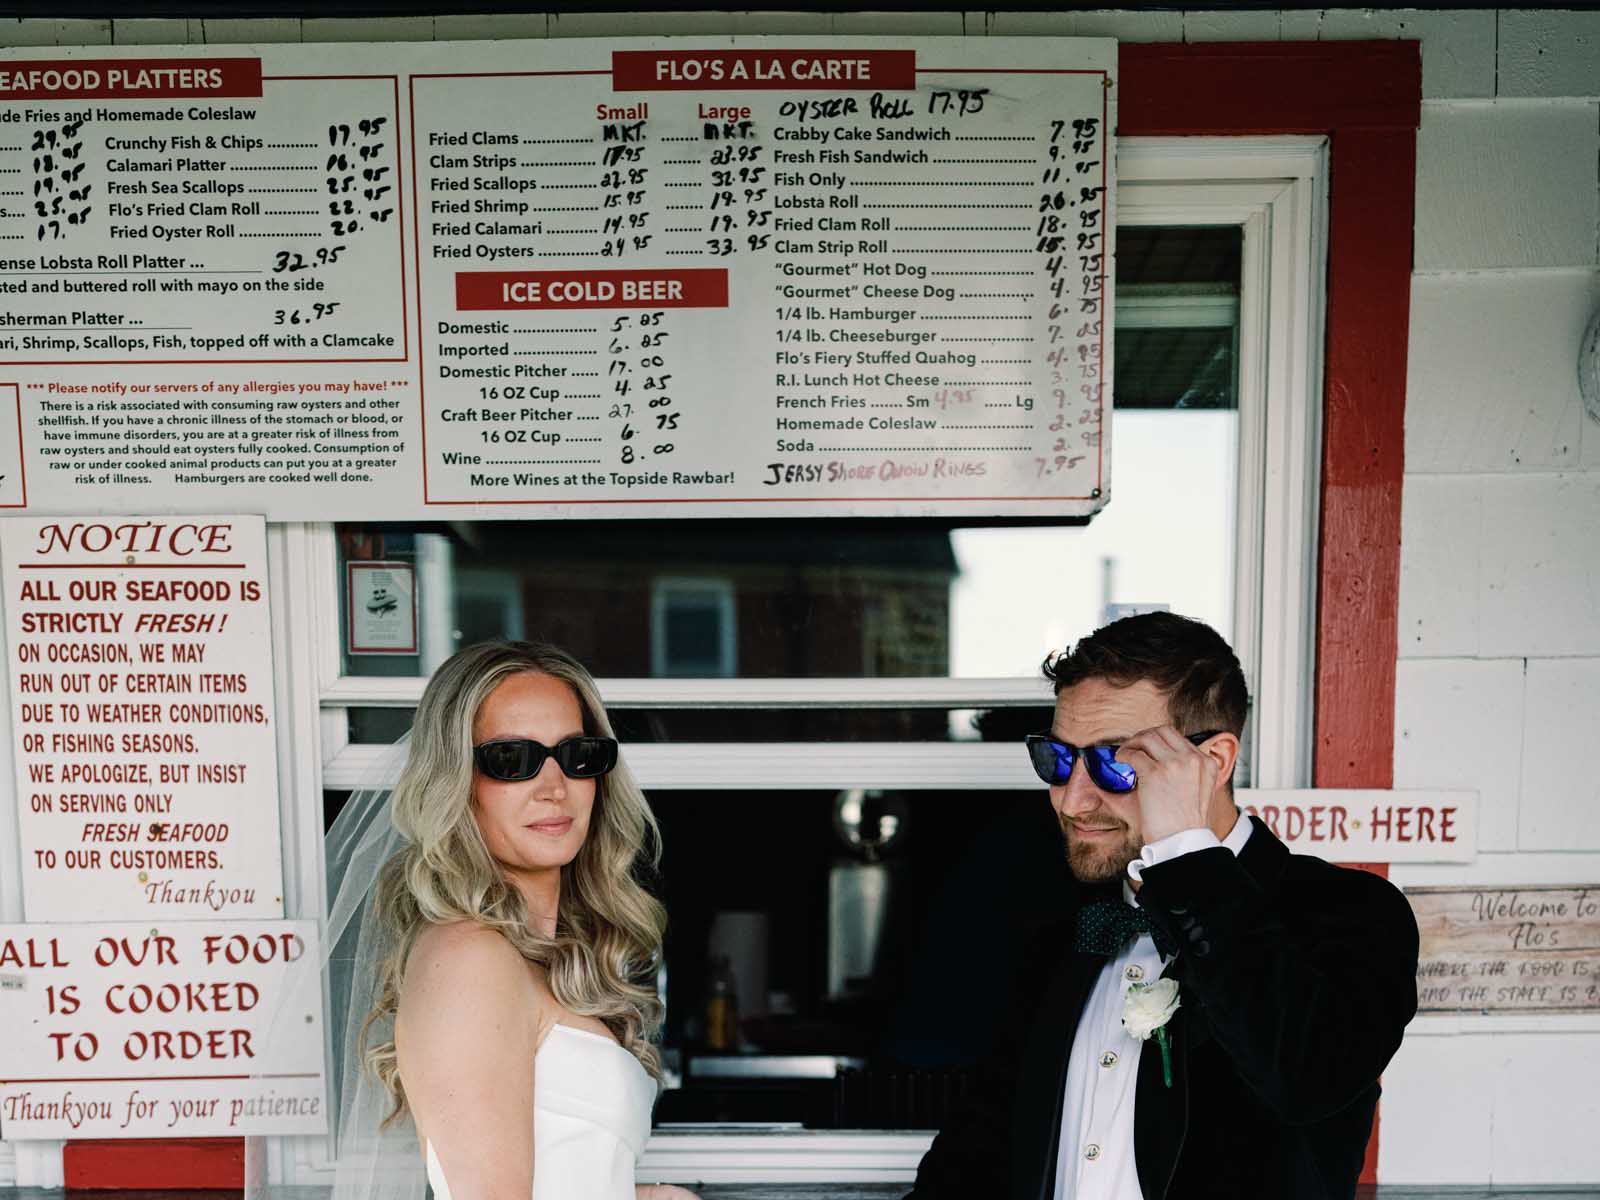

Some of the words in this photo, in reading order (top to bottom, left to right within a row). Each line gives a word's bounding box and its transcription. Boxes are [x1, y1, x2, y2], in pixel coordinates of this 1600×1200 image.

[108, 69, 222, 89] PLATTERS
[657, 60, 724, 80] FLO'S
[731, 60, 748, 79] A
[756, 60, 785, 79] LA
[792, 60, 870, 79] CARTE
[25, 109, 60, 123] Fries
[64, 108, 92, 122] and
[96, 107, 184, 122] Homemade
[188, 106, 256, 120] Coleslaw
[597, 103, 648, 120] Small
[699, 103, 751, 123] Large
[779, 97, 859, 123] OYSTER
[928, 88, 989, 117] 17.95
[105, 136, 167, 153] Crunchy
[171, 135, 201, 149] Fish
[205, 136, 217, 149] &
[221, 135, 263, 152] Chips
[429, 131, 468, 146] Fried
[472, 131, 519, 145] Clams
[774, 126, 830, 144] Crabby
[833, 126, 872, 141] Cake
[876, 126, 951, 141] Sandwich
[106, 158, 172, 172] Calamari
[176, 157, 227, 171] Platter
[430, 154, 469, 168] Clam
[473, 154, 517, 171] Strips
[774, 149, 815, 163] Fresh
[819, 149, 850, 163] Fish
[854, 149, 928, 163] Sandwich
[431, 177, 469, 191] Fried
[473, 176, 537, 194] Scallops
[774, 172, 805, 186] Fish
[809, 172, 846, 190] Only
[109, 203, 143, 216] Flo's
[147, 202, 185, 216] Fried
[189, 202, 227, 216] Clam
[231, 201, 260, 215] Roll
[432, 199, 470, 214] Fried
[474, 198, 529, 216] Shrimp
[774, 194, 825, 208] Lobsta
[829, 194, 858, 208] Roll
[432, 221, 471, 236] Fried
[475, 221, 542, 235] Calamari
[775, 217, 813, 231] Fried
[817, 217, 856, 231] Clam
[861, 217, 890, 231] Roll
[433, 244, 471, 258] Fried
[476, 244, 534, 261] Oysters
[774, 240, 814, 254] Clam
[818, 240, 854, 257] Strip
[858, 240, 887, 253] Roll
[40, 254, 93, 270] Lobsta
[97, 254, 128, 269] Roll
[133, 254, 186, 269] Platter
[272, 245, 346, 273] 32.95
[863, 262, 891, 276] Hot
[895, 263, 926, 279] Dog
[503, 282, 541, 302] ICE
[548, 282, 615, 301] COLD
[623, 281, 682, 300] BEER
[274, 302, 341, 325] 36.95
[776, 306, 802, 320] 1/4
[806, 306, 825, 320] lb.
[829, 306, 917, 323] Hamburger
[438, 320, 509, 335] Domestic
[439, 342, 509, 360] Imported
[776, 351, 810, 364] Flo's
[815, 351, 852, 368] Fiery
[856, 350, 911, 364] Stuffed
[915, 350, 976, 367] Quahog
[440, 364, 510, 378] Domestic
[514, 363, 567, 378] Pitcher
[48, 382, 88, 394] Please
[91, 382, 127, 396] notify
[201, 381, 214, 392] of
[217, 384, 239, 395] any
[243, 381, 295, 395] allergies
[298, 384, 321, 395] you
[325, 384, 350, 394] may
[353, 380, 387, 391] have!
[480, 387, 499, 400] 16
[502, 386, 526, 399] OZ
[529, 386, 560, 403] Cup
[776, 395, 826, 408] French
[831, 395, 866, 408] Fries
[907, 395, 930, 407] Sm
[1016, 395, 1034, 411] Lg
[777, 438, 814, 452] Soda
[442, 452, 482, 464] Wine
[175, 473, 245, 485] Hamburgers
[248, 475, 266, 483] are
[269, 472, 311, 483] cooked
[313, 472, 338, 482] well
[340, 472, 373, 482] done.
[470, 474, 509, 486] More
[513, 473, 559, 486] Wines
[563, 474, 578, 485] at
[581, 472, 606, 485] the
[609, 472, 668, 488] Topside
[672, 471, 734, 484] Rawbar!
[36, 521, 232, 556] NOTICE
[20, 580, 61, 601] ALL
[69, 580, 117, 602] OUR
[126, 580, 231, 602] SEAFOOD
[240, 580, 261, 602] IS
[21, 612, 124, 634] STRICTLY
[18, 643, 40, 663] ON
[48, 643, 133, 666] OCCASION,
[139, 643, 165, 663] WE
[172, 643, 205, 663] MAY
[20, 673, 53, 693] RUN
[61, 673, 91, 693] OUT
[98, 673, 118, 693] OF
[126, 673, 191, 693] CERTAIN
[200, 674, 247, 693] ITEMS
[22, 704, 54, 723] DUE
[60, 704, 80, 723] TO
[86, 704, 162, 723] WEATHER
[169, 704, 268, 726] CONDITIONS,
[23, 733, 44, 753] OR
[52, 733, 115, 753] FISHING
[122, 734, 198, 753] SEASONS.
[29, 764, 54, 783] WE
[61, 764, 152, 786] APOLOGIZE,
[160, 764, 190, 784] BUT
[197, 764, 246, 784] INSIST
[31, 794, 52, 813] ON
[59, 794, 127, 813] SERVING
[134, 794, 172, 813] ONLY
[81, 823, 141, 842] FRESH
[146, 822, 229, 842] SEAFOOD
[1246, 805, 1349, 842] RDER
[1370, 805, 1458, 842] HERE
[34, 850, 56, 869] TO
[65, 850, 101, 869] OUR
[110, 850, 223, 869] CUSTOMERS.
[145, 880, 255, 911] Thankyou
[1472, 893, 1568, 920] Welcome
[1574, 889, 1597, 918] to
[0, 938, 70, 968] ALL
[94, 936, 179, 967] OUR
[203, 933, 304, 965] FOOD
[45, 985, 80, 1015] IS
[105, 982, 259, 1014] COOKED
[48, 1032, 99, 1062] TO
[123, 1029, 255, 1061] ORDER
[4, 1091, 112, 1129] Thankyou
[120, 1090, 159, 1128] for
[168, 1099, 219, 1127] your
[230, 1090, 320, 1127] patience
